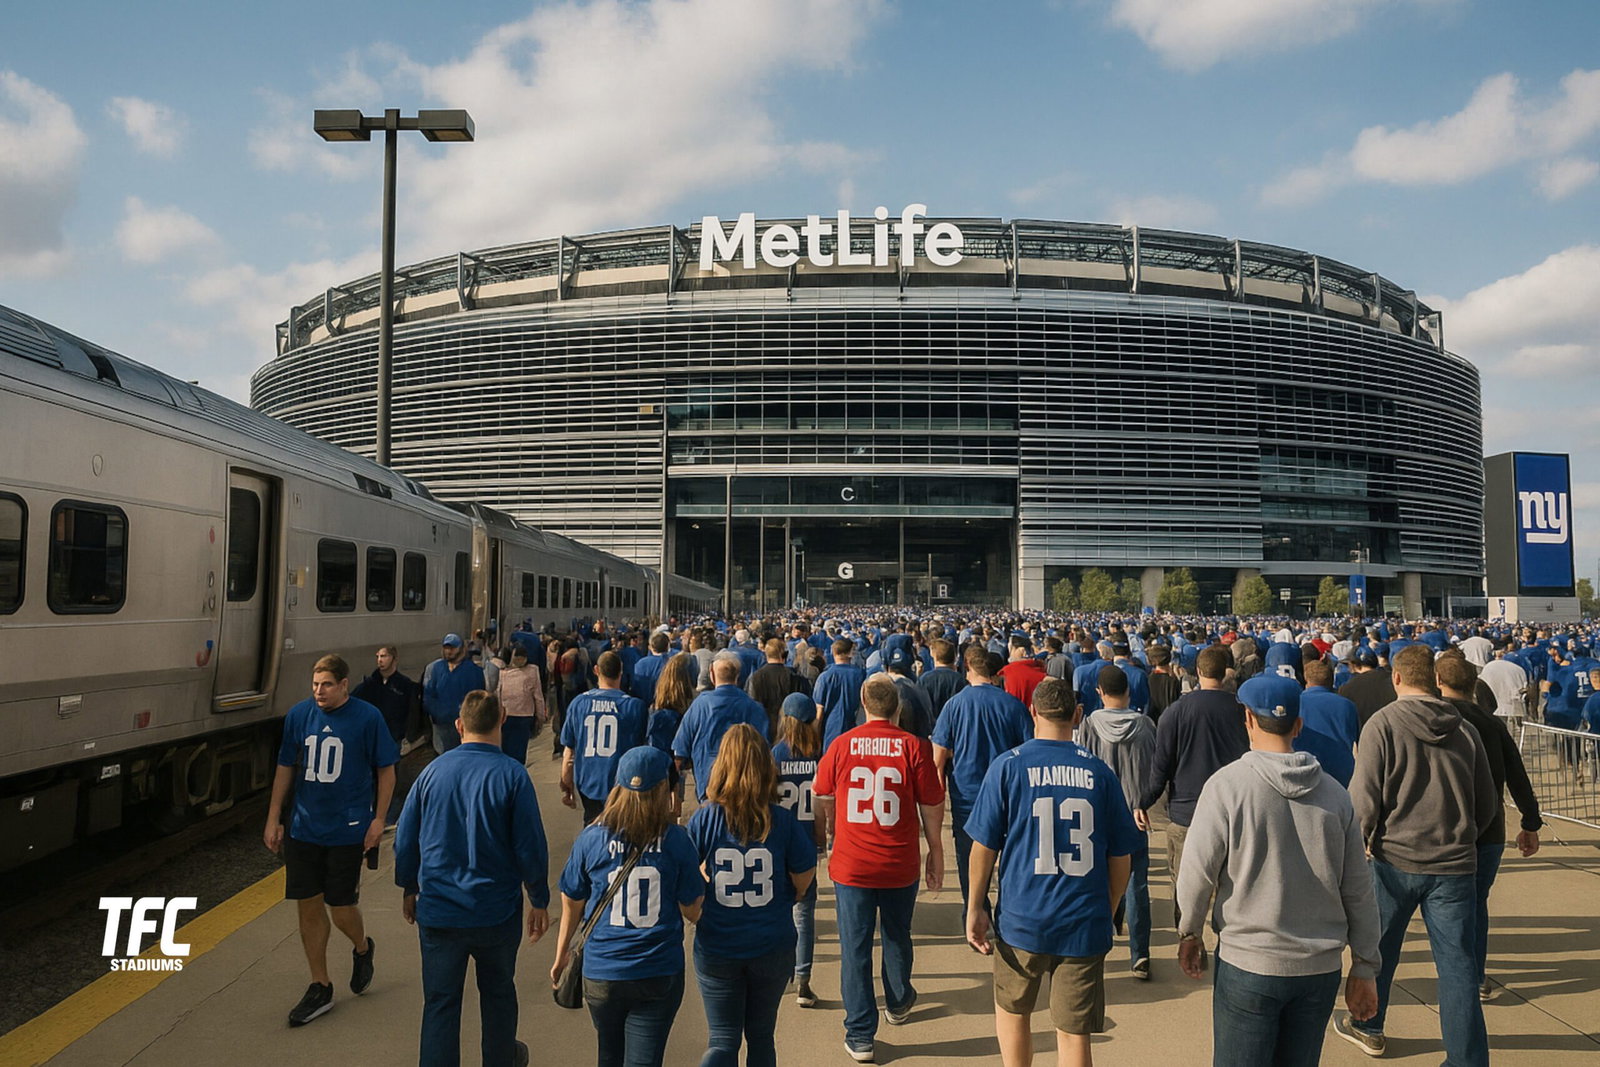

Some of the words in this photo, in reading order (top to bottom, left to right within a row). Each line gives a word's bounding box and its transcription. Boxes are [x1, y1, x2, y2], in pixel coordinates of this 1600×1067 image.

[700, 203, 964, 270] MetLife
[841, 487, 854, 501] C
[1519, 491, 1567, 544] ny
[838, 562, 854, 579] G
[304, 735, 344, 783] 10
[584, 714, 618, 757] 10
[847, 766, 902, 827] 26
[1027, 765, 1094, 790] WANKING
[1032, 797, 1094, 876] 13
[608, 866, 661, 928] 10
[715, 848, 774, 907] 23
